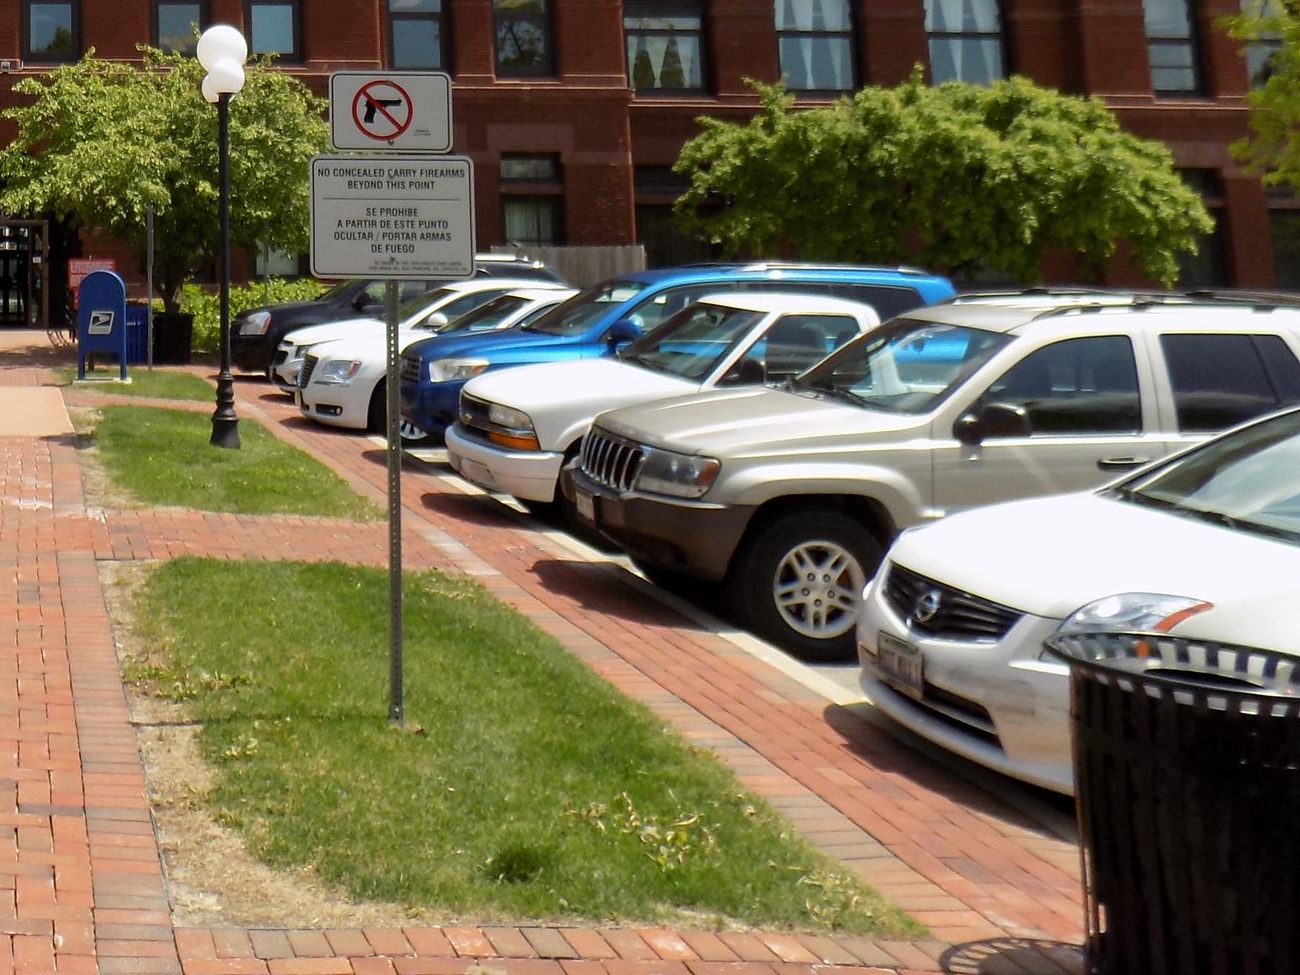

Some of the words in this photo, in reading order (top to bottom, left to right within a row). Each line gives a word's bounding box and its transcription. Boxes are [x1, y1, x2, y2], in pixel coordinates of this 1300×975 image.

[317, 168, 330, 177] NO
[333, 168, 385, 177] CONCEALED
[387, 169, 417, 178] CARRY
[420, 169, 465, 178] FIREARMS
[347, 180, 383, 189] BEYOND
[386, 180, 406, 189] THIS
[409, 181, 435, 190] POINT
[366, 207, 377, 217] SE
[380, 207, 418, 217] PROHIBE
[337, 220, 343, 228] A
[345, 220, 377, 228] PARTIR
[380, 220, 391, 229] DE
[394, 220, 416, 229] ESTE
[419, 220, 449, 229] PUNTO
[334, 231, 374, 240] OCULTAR
[382, 232, 417, 241] PORTAR
[420, 232, 452, 241] ARMAS
[371, 244, 382, 253] DE
[385, 244, 415, 253] FUEGO
